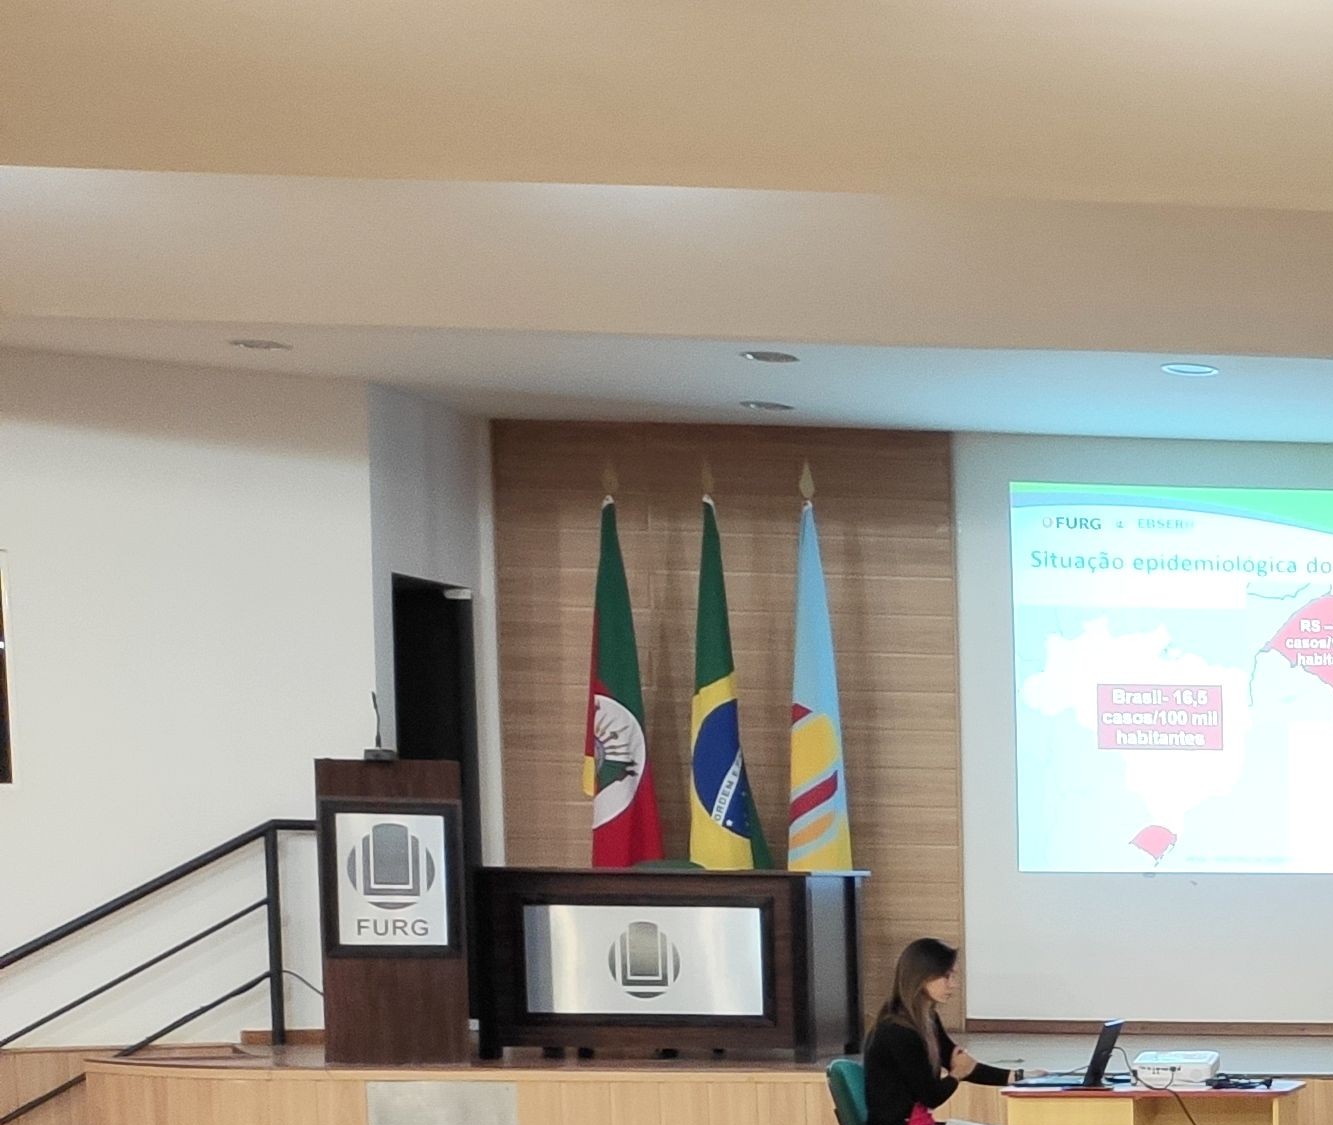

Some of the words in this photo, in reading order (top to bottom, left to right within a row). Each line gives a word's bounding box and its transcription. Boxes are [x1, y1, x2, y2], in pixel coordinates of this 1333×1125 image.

[1055, 516, 1102, 531] FURG
[1031, 550, 1124, 573] Situação
[1132, 554, 1297, 577] epidemiológica
[1306, 557, 1332, 574] do
[1299, 619, 1322, 633] RS
[1102, 709, 1188, 726] casos/100
[1191, 710, 1219, 727] mil
[1116, 728, 1206, 746] habitantes
[356, 918, 429, 937] FURG
